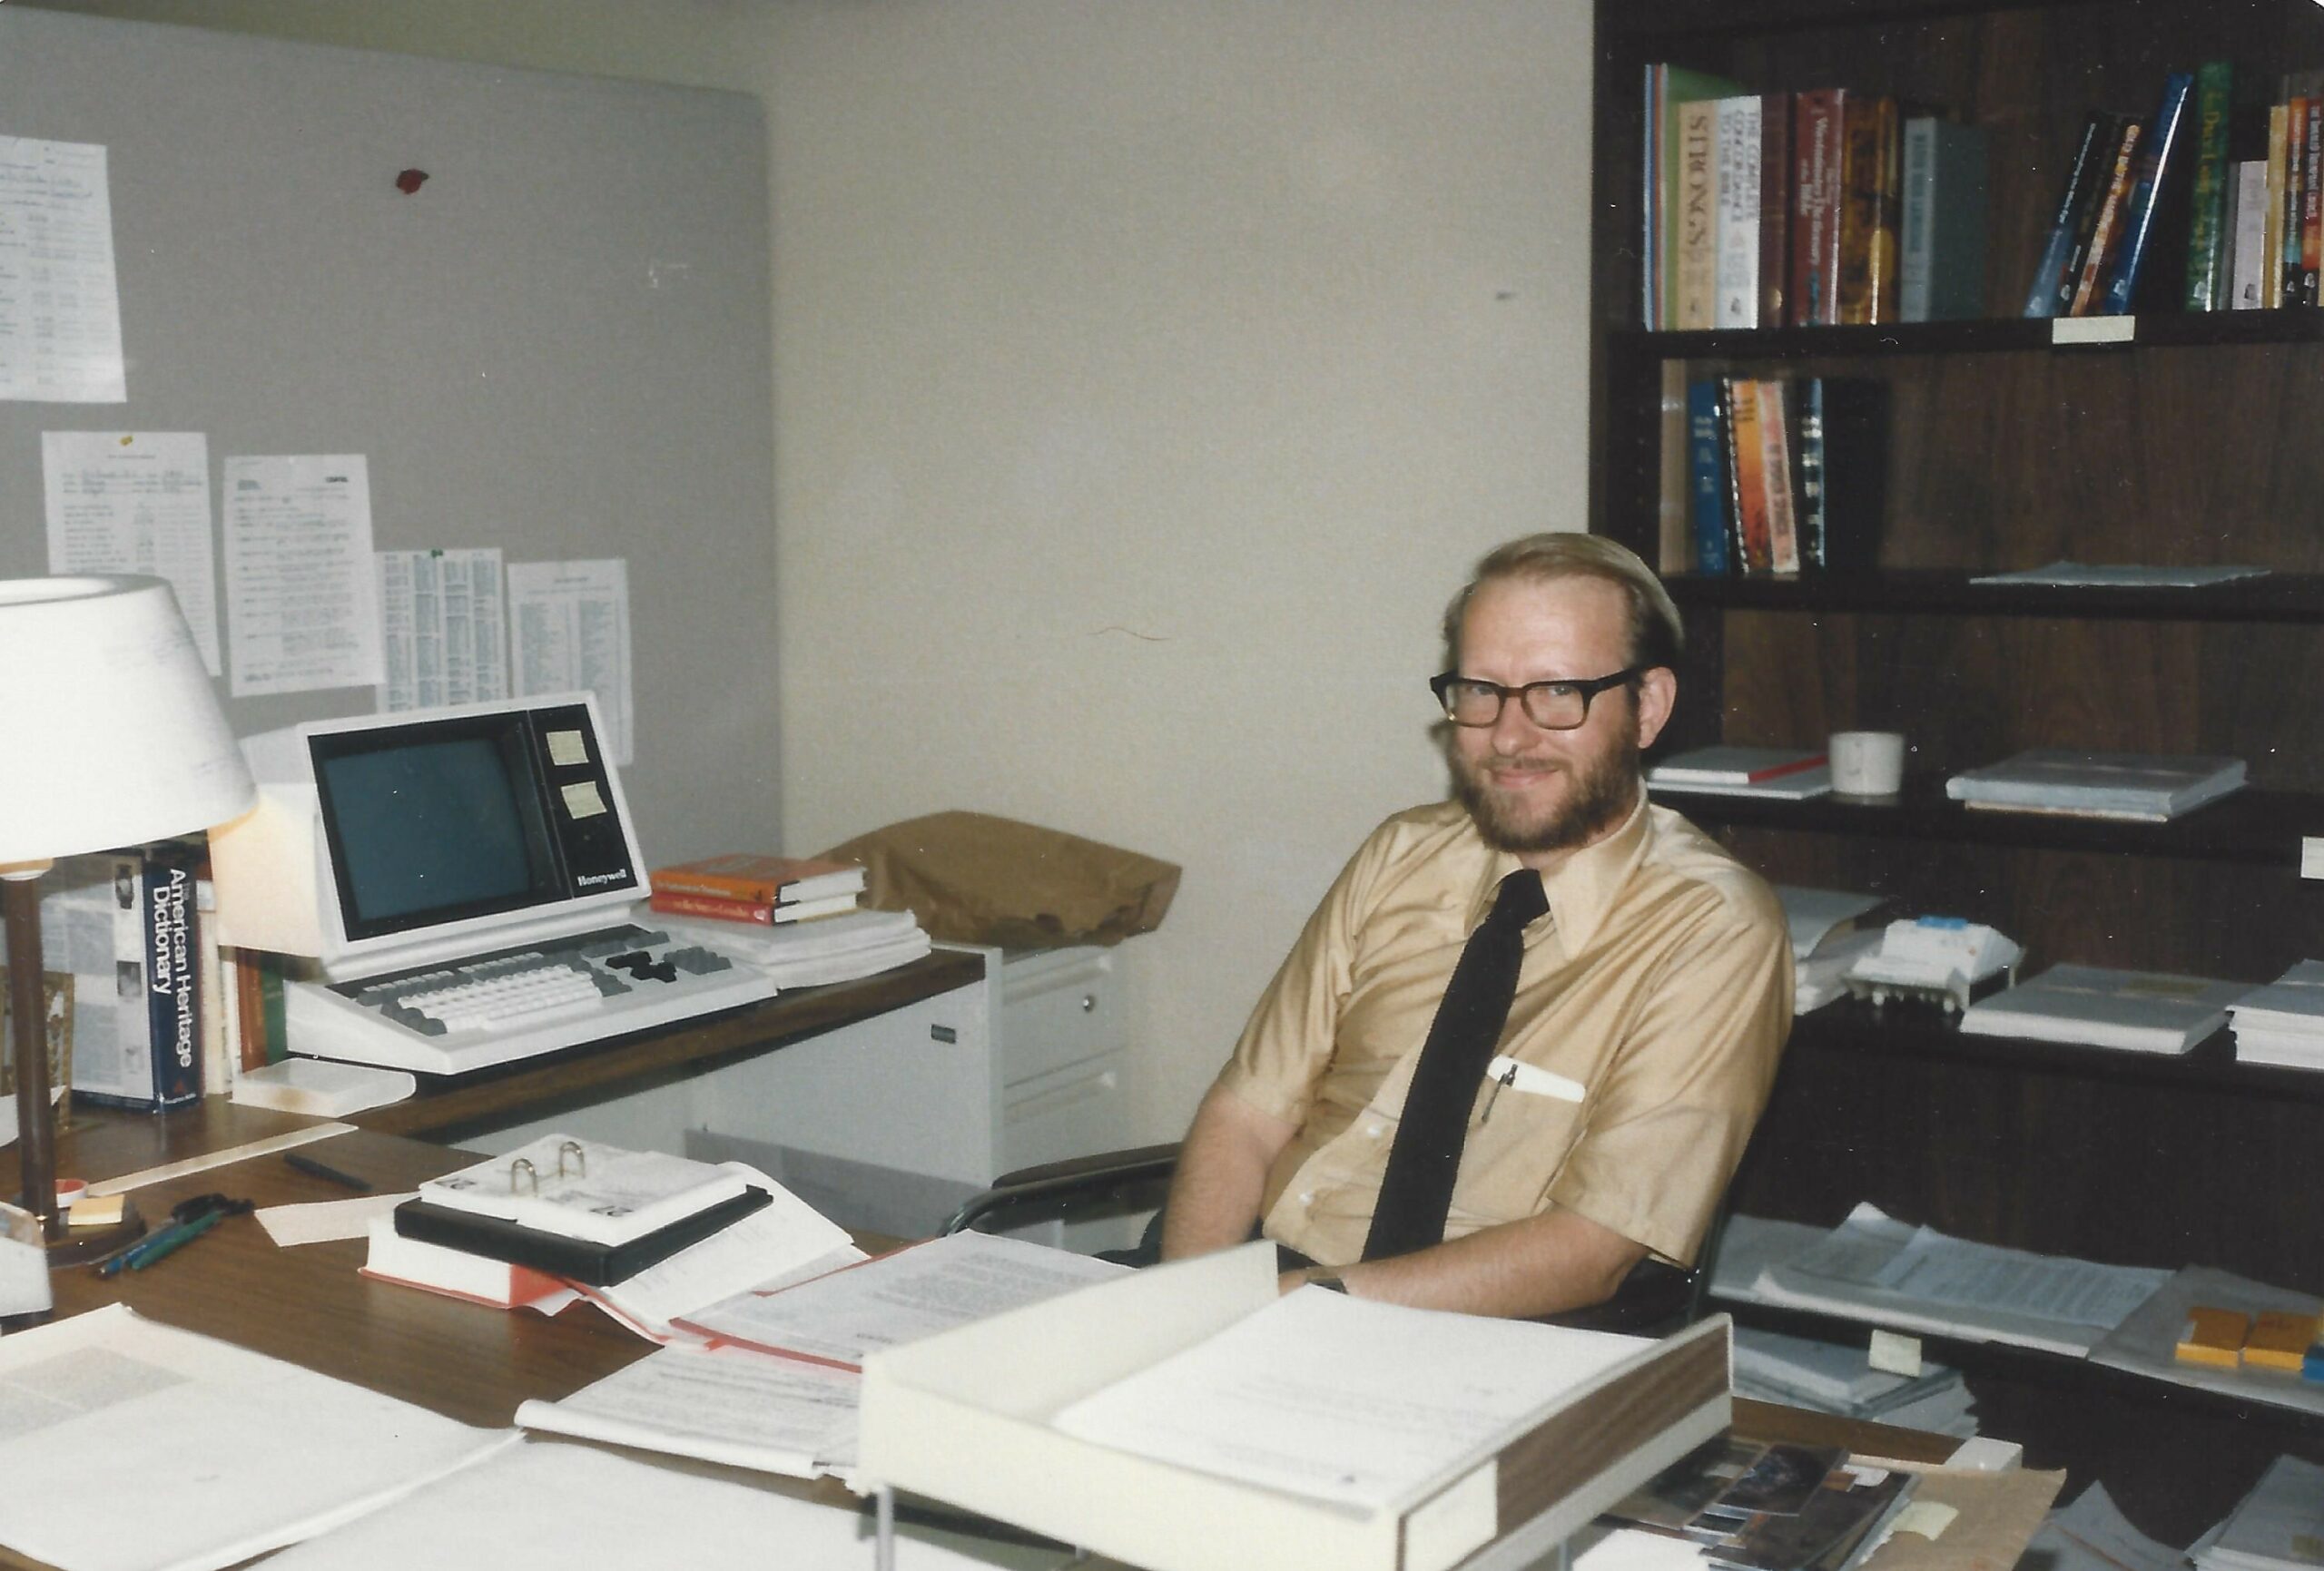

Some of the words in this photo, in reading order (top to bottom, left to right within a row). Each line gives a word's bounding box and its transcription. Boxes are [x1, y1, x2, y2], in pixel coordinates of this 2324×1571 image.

[1731, 110, 1745, 222] CONCORDANCE
[1747, 112, 1758, 138] THE
[1720, 171, 1730, 206] BIBLE
[1745, 144, 1758, 220] COMPLETE
[577, 869, 626, 886] Honeywell
[153, 886, 172, 994] Dictionary
[170, 869, 189, 972] American
[176, 975, 192, 1067] Heritage
